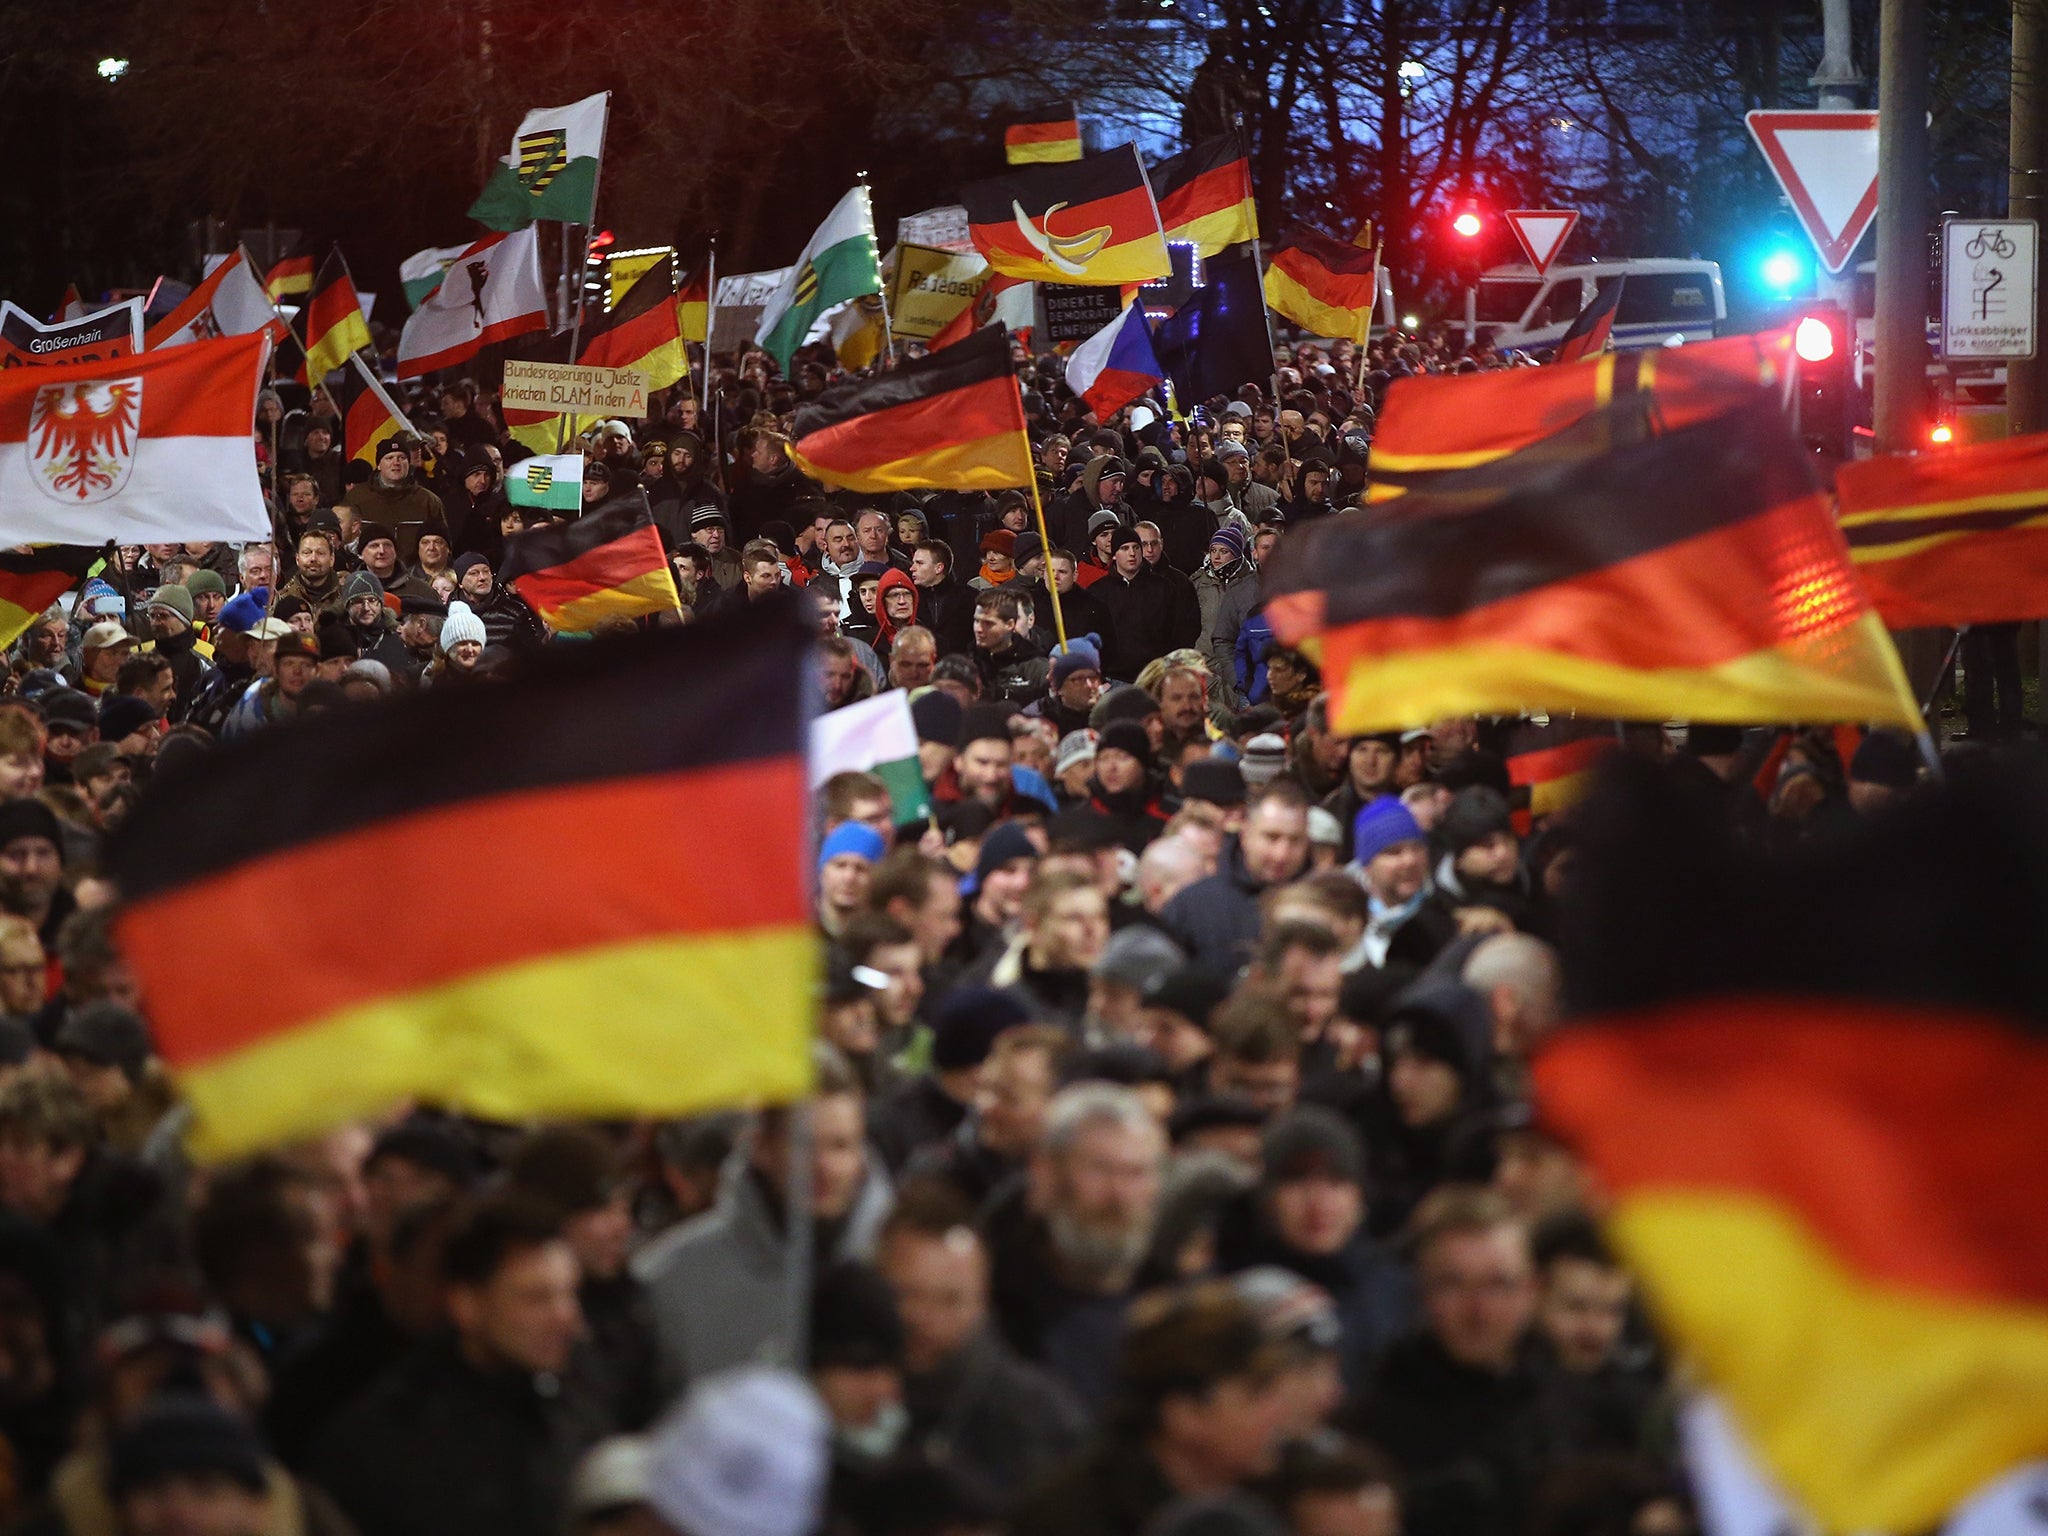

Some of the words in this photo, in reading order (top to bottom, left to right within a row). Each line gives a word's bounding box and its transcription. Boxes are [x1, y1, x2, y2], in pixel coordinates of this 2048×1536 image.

[1047, 294, 1105, 310] DIREKTE
[1047, 307, 1121, 322] DEMOKRATIE
[1950, 325, 2028, 337] Linksabbieger
[30, 328, 101, 353] Großenhain
[1953, 340, 1966, 348] so
[1971, 339, 2026, 348] einordnen
[505, 361, 592, 386] Bundesregierung
[595, 372, 604, 384] u
[603, 369, 641, 389] Justiz
[503, 384, 546, 402] kriechen
[550, 386, 592, 406] ISLAM
[628, 388, 646, 410] A.
